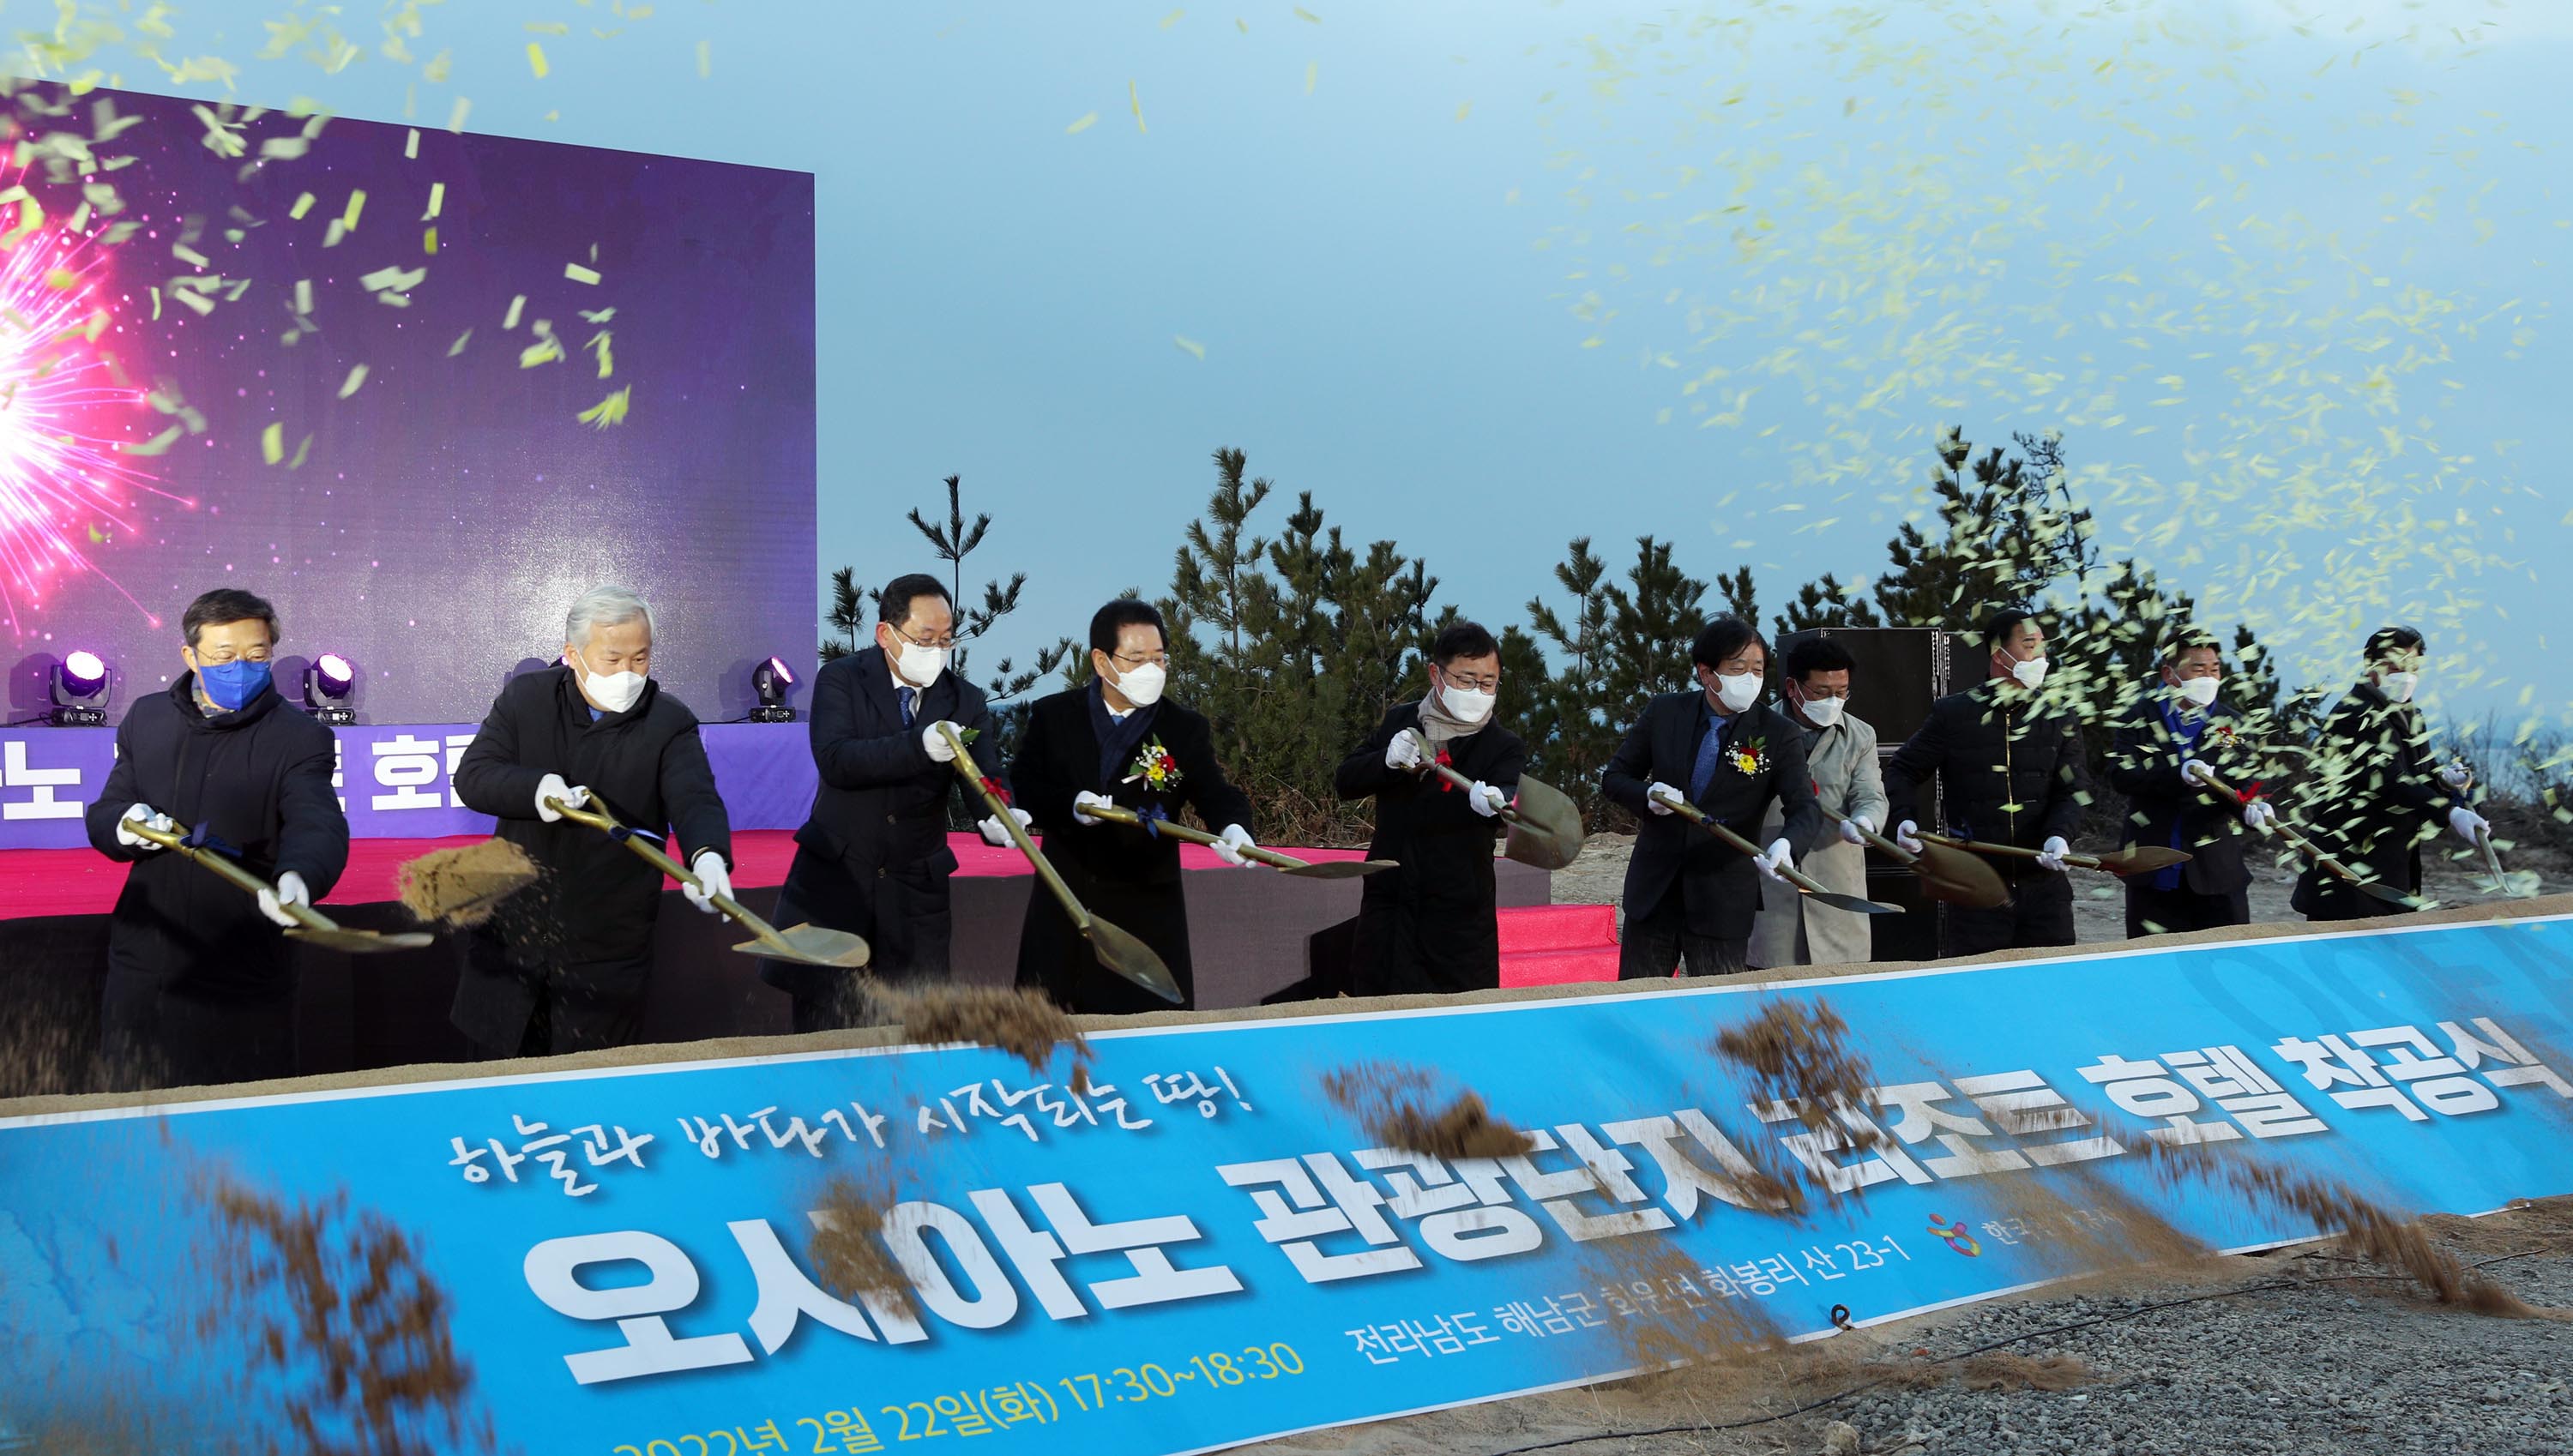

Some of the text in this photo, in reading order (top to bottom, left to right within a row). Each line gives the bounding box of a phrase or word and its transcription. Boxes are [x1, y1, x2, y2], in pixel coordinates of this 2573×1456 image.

[0, 741, 84, 821] 노
[449, 1066, 1252, 1197] 하늘과 바다가 시작되는 땅!
[523, 1182, 1244, 1385] 오시아노
[1215, 1109, 1790, 1283] 관광단지
[2076, 1044, 2329, 1146] 호텔
[2270, 1017, 2573, 1122] 착공식
[1345, 1311, 1501, 1365] 전라남도
[1493, 1292, 1608, 1338] 해남군
[1701, 1253, 1811, 1300] 화봉리
[1801, 1246, 1846, 1281] 산
[1835, 1235, 1911, 1271] 23-1
[797, 1406, 884, 1455] 2월
[880, 1381, 1059, 1441] 22일(화)
[1059, 1342, 1305, 1411] 17:30~18:30
